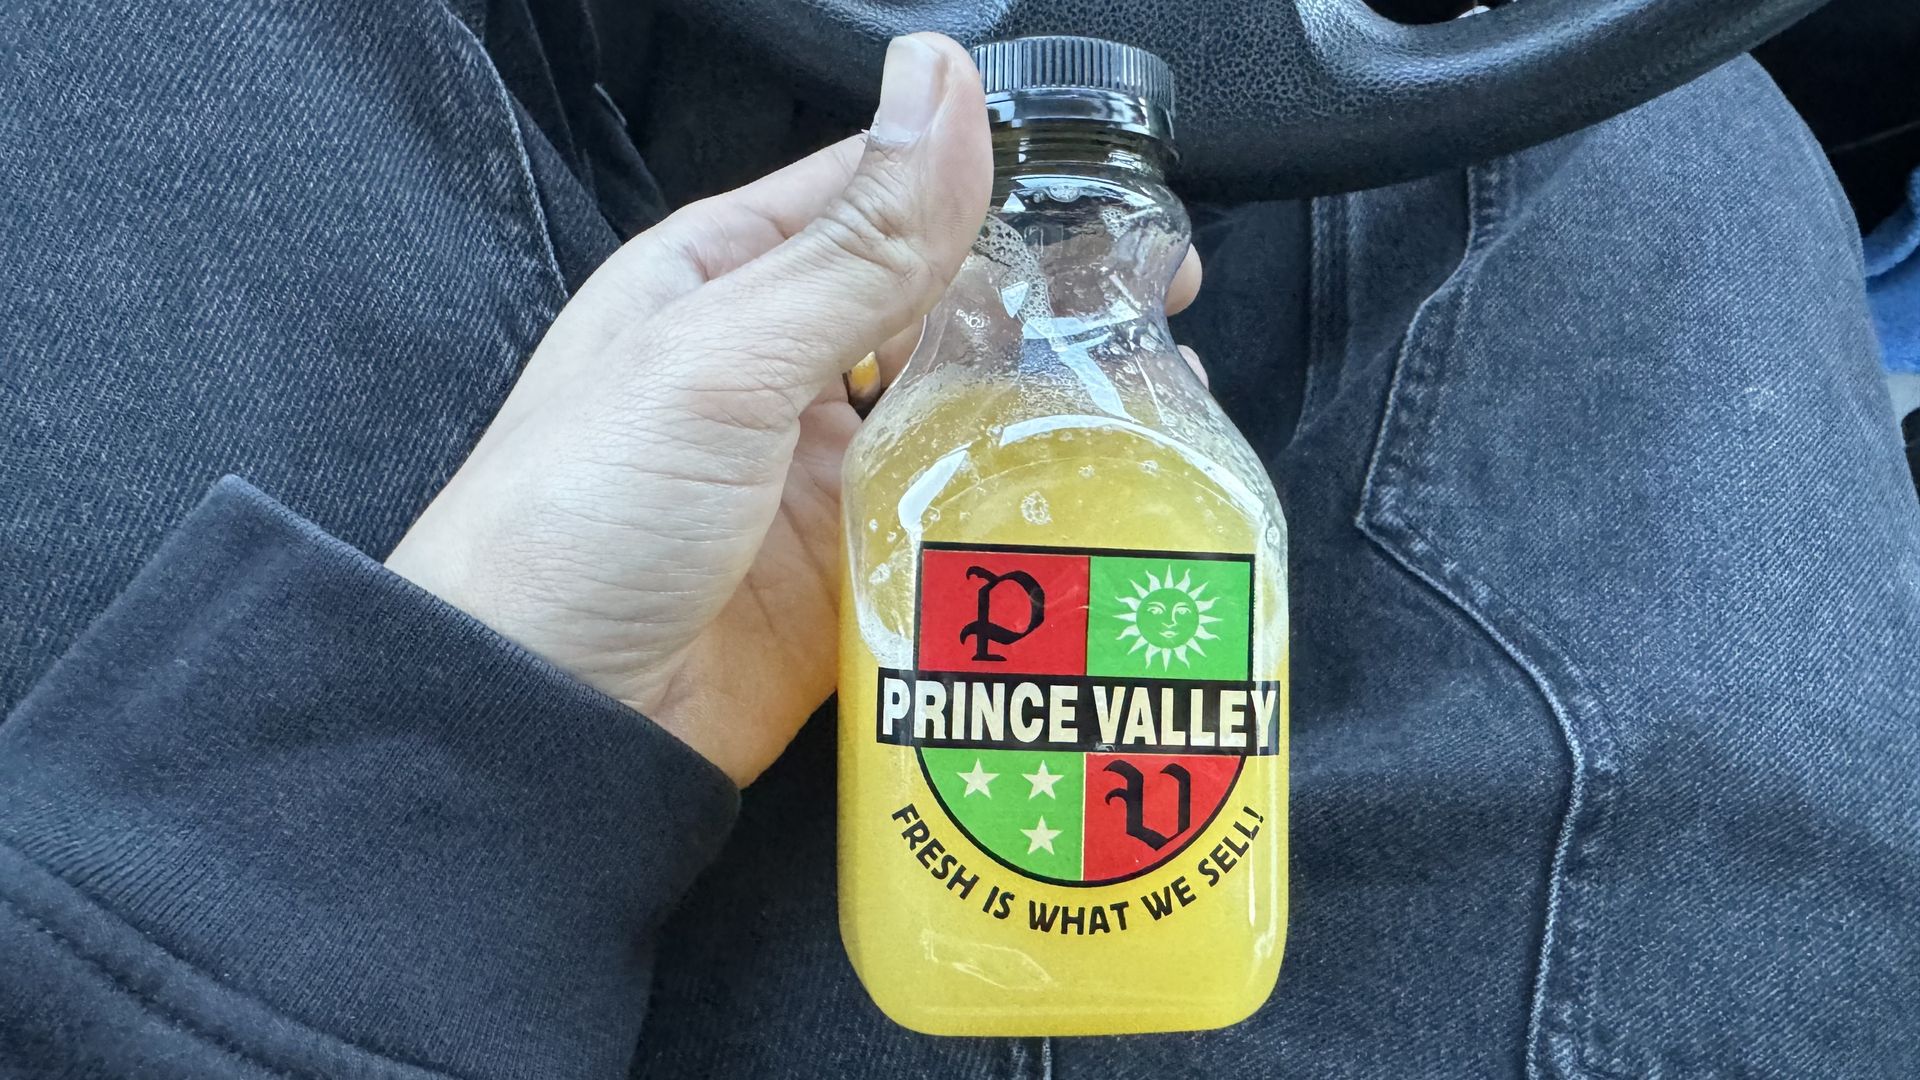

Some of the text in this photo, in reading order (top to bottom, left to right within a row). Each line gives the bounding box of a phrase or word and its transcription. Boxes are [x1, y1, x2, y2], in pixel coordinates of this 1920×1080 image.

[882, 677, 1278, 748] PRINCE VALLEY
[891, 802, 1265, 936] FRESH IS WHAT WE SELL!
